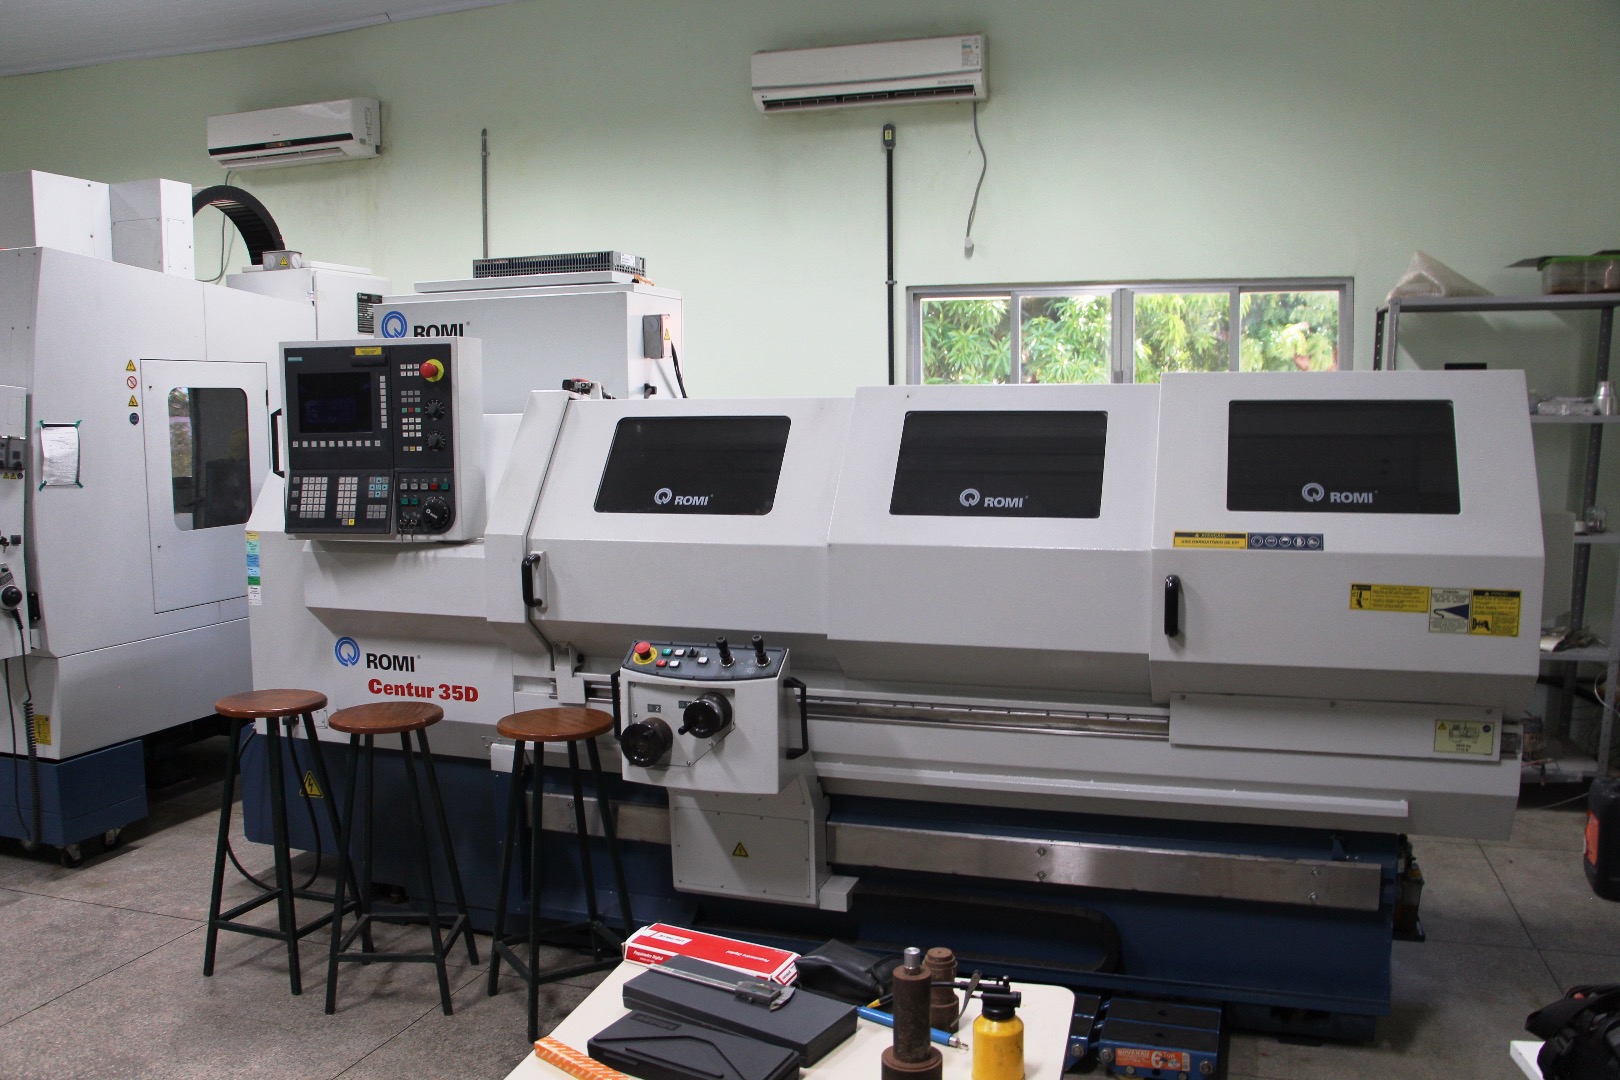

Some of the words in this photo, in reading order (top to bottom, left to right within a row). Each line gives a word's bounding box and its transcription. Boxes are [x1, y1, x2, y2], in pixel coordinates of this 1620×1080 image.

[413, 323, 464, 338] ROMI
[673, 495, 709, 506] ROMI
[983, 496, 1024, 508] ROMI
[1329, 491, 1374, 504] ROMI
[366, 652, 415, 672] ROMI
[368, 678, 435, 699] Centur
[438, 683, 479, 703] 35D
